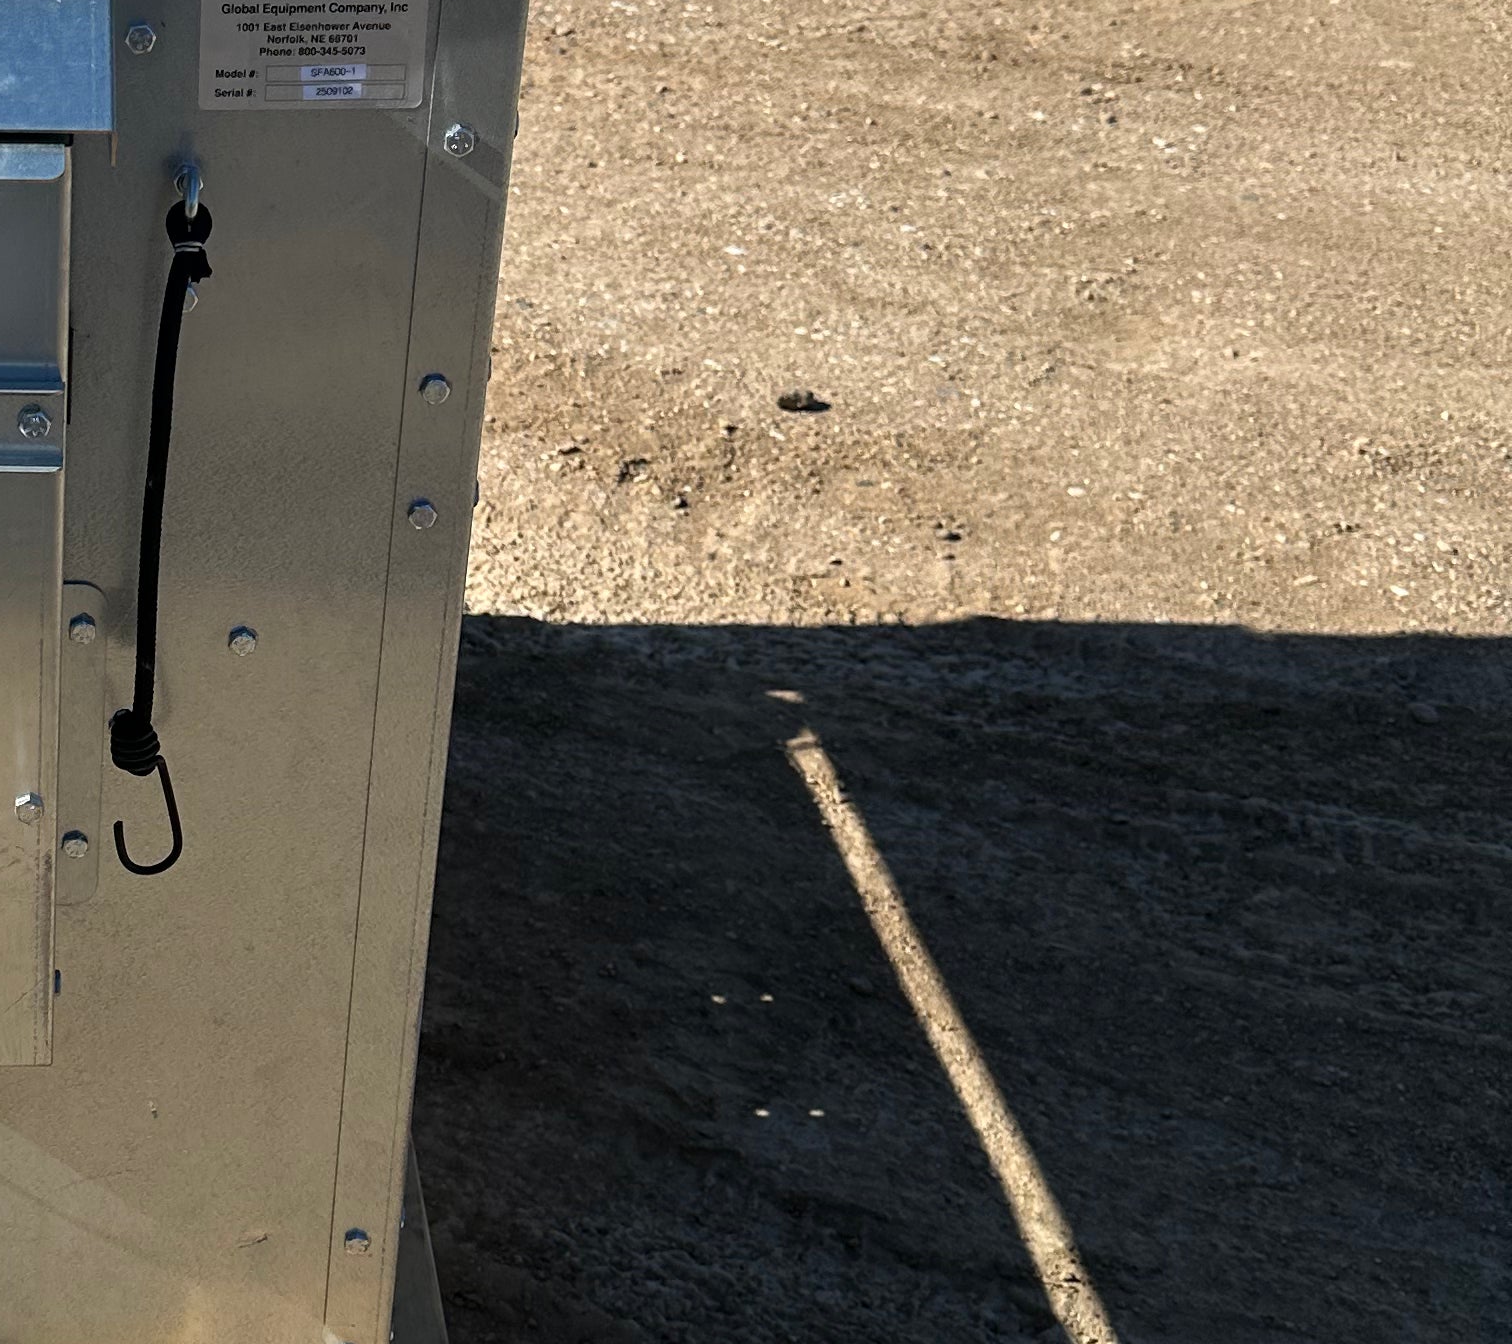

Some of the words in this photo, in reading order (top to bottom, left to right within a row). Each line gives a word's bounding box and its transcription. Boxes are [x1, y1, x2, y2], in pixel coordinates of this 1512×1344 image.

[221, 3, 259, 15] Global
[263, 2, 326, 16] Equipment
[328, 2, 387, 15] Company,
[390, 1, 409, 13] Inc
[236, 22, 260, 32] 1001
[263, 22, 287, 32] East
[289, 21, 350, 32] Eisenhower
[352, 21, 392, 31] Avenue
[267, 34, 308, 44] Norfolk,
[311, 34, 326, 44] NE
[215, 69, 246, 78] Model
[214, 88, 244, 97] Serial
